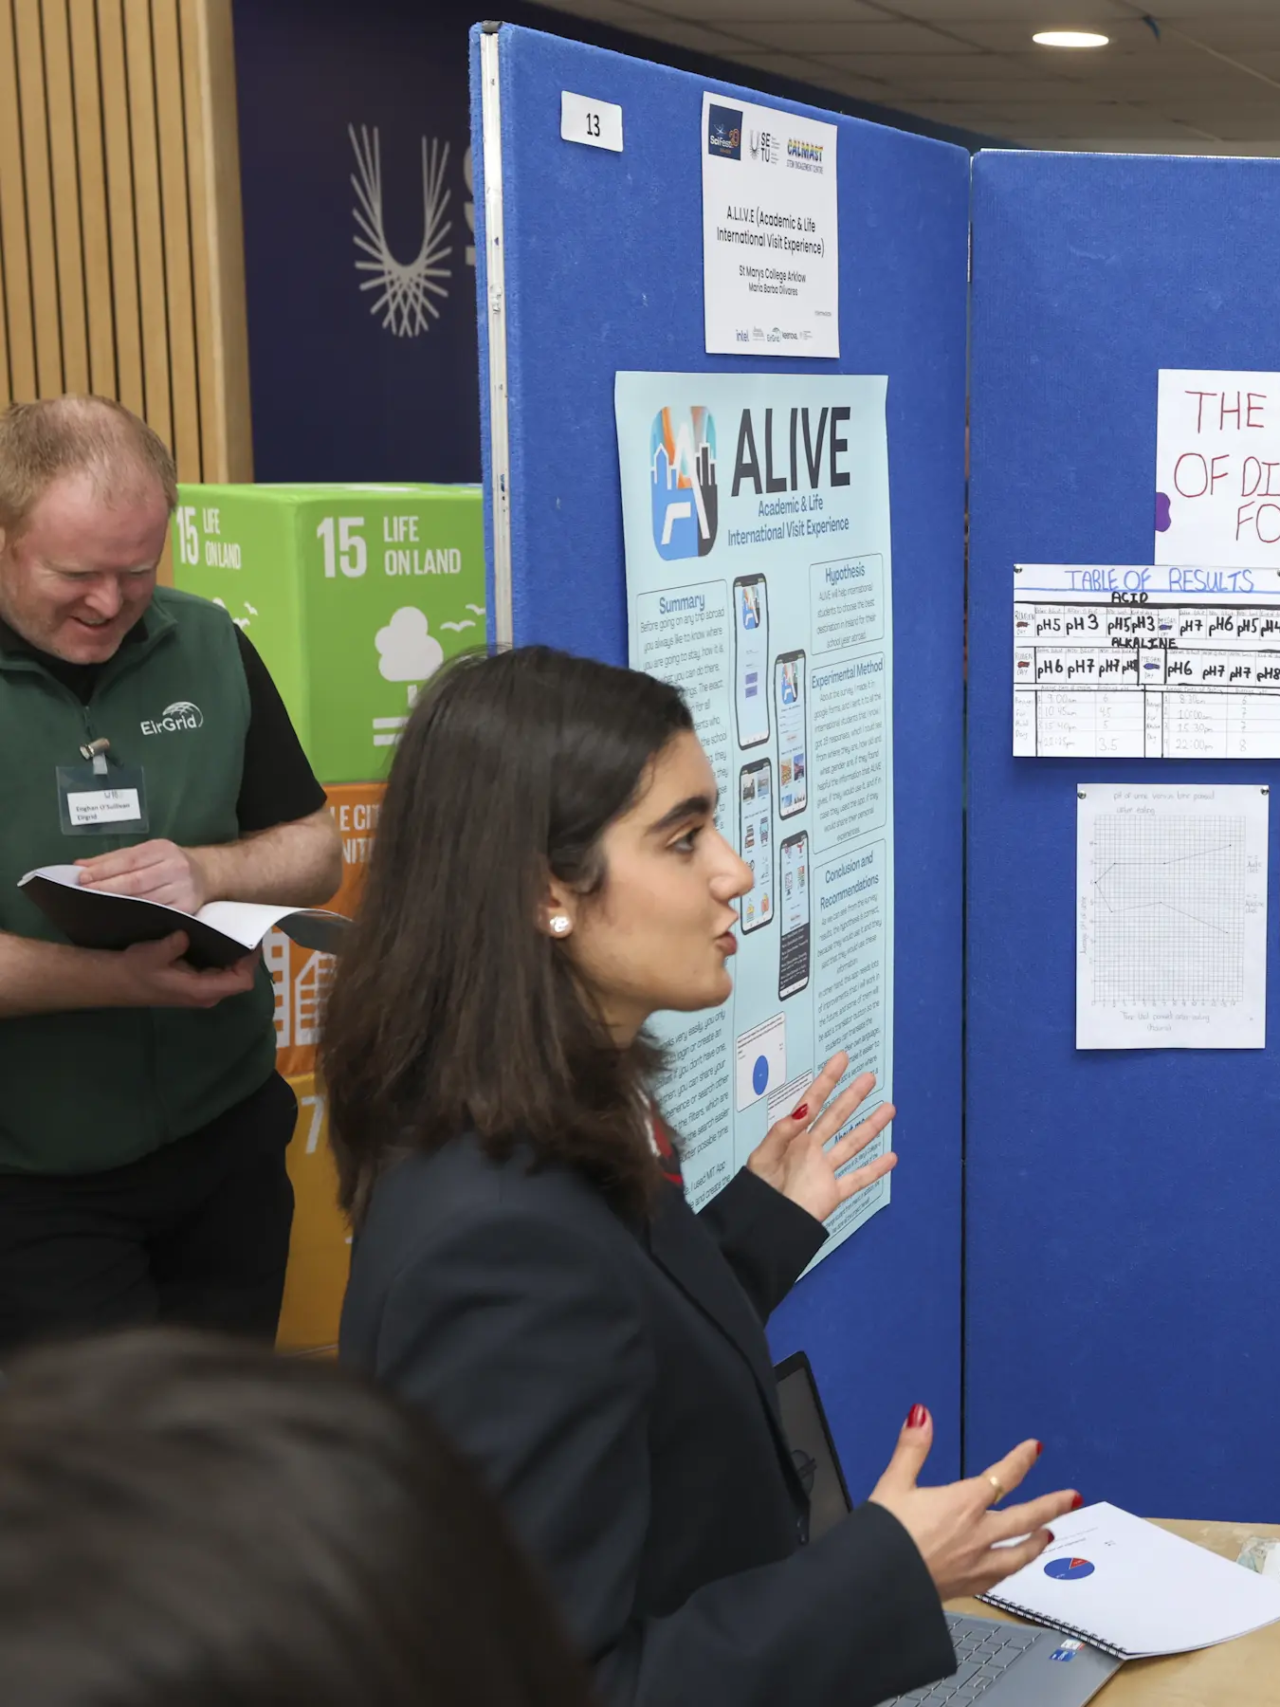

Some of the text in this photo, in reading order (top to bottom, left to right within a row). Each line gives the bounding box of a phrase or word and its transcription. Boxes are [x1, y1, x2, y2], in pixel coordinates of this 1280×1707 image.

[586, 112, 601, 138] 13
[761, 132, 770, 147] SE
[787, 137, 824, 162] CALMAST
[761, 148, 770, 162] TU
[756, 206, 796, 230] (Academic
[797, 218, 802, 230] &
[804, 218, 816, 232] Life
[717, 226, 824, 258] International Visit Experience)
[739, 265, 806, 284] St Marys College Arklow
[748, 282, 798, 296] Maria Barba Olivares
[1185, 391, 1266, 434] THE
[731, 407, 850, 497] ALIVE
[1174, 452, 1230, 498] OF
[758, 494, 824, 516] Academic & Life
[203, 508, 220, 534] LIFE
[384, 516, 420, 542] LIFE
[728, 516, 850, 546] International Visit Experience
[176, 506, 200, 564] 15
[317, 516, 367, 578] 15
[206, 541, 242, 570] ON LAND
[384, 548, 462, 576] ON LAND
[826, 562, 866, 586] Hypothesis
[1064, 568, 1254, 592] TABLE OF RESULTS
[660, 594, 705, 614] Summary
[1112, 591, 1148, 603] ACID
[1108, 616, 1131, 636] pH5
[1132, 616, 1155, 634] pH3
[1180, 620, 1203, 636] pH7
[1208, 616, 1234, 637] pH6
[1238, 618, 1260, 637] pH5
[1112, 637, 1178, 650] ALKALINE
[812, 658, 883, 688] Experimental Method
[826, 850, 874, 884] Conclusion and
[820, 874, 879, 912] Recommendations
